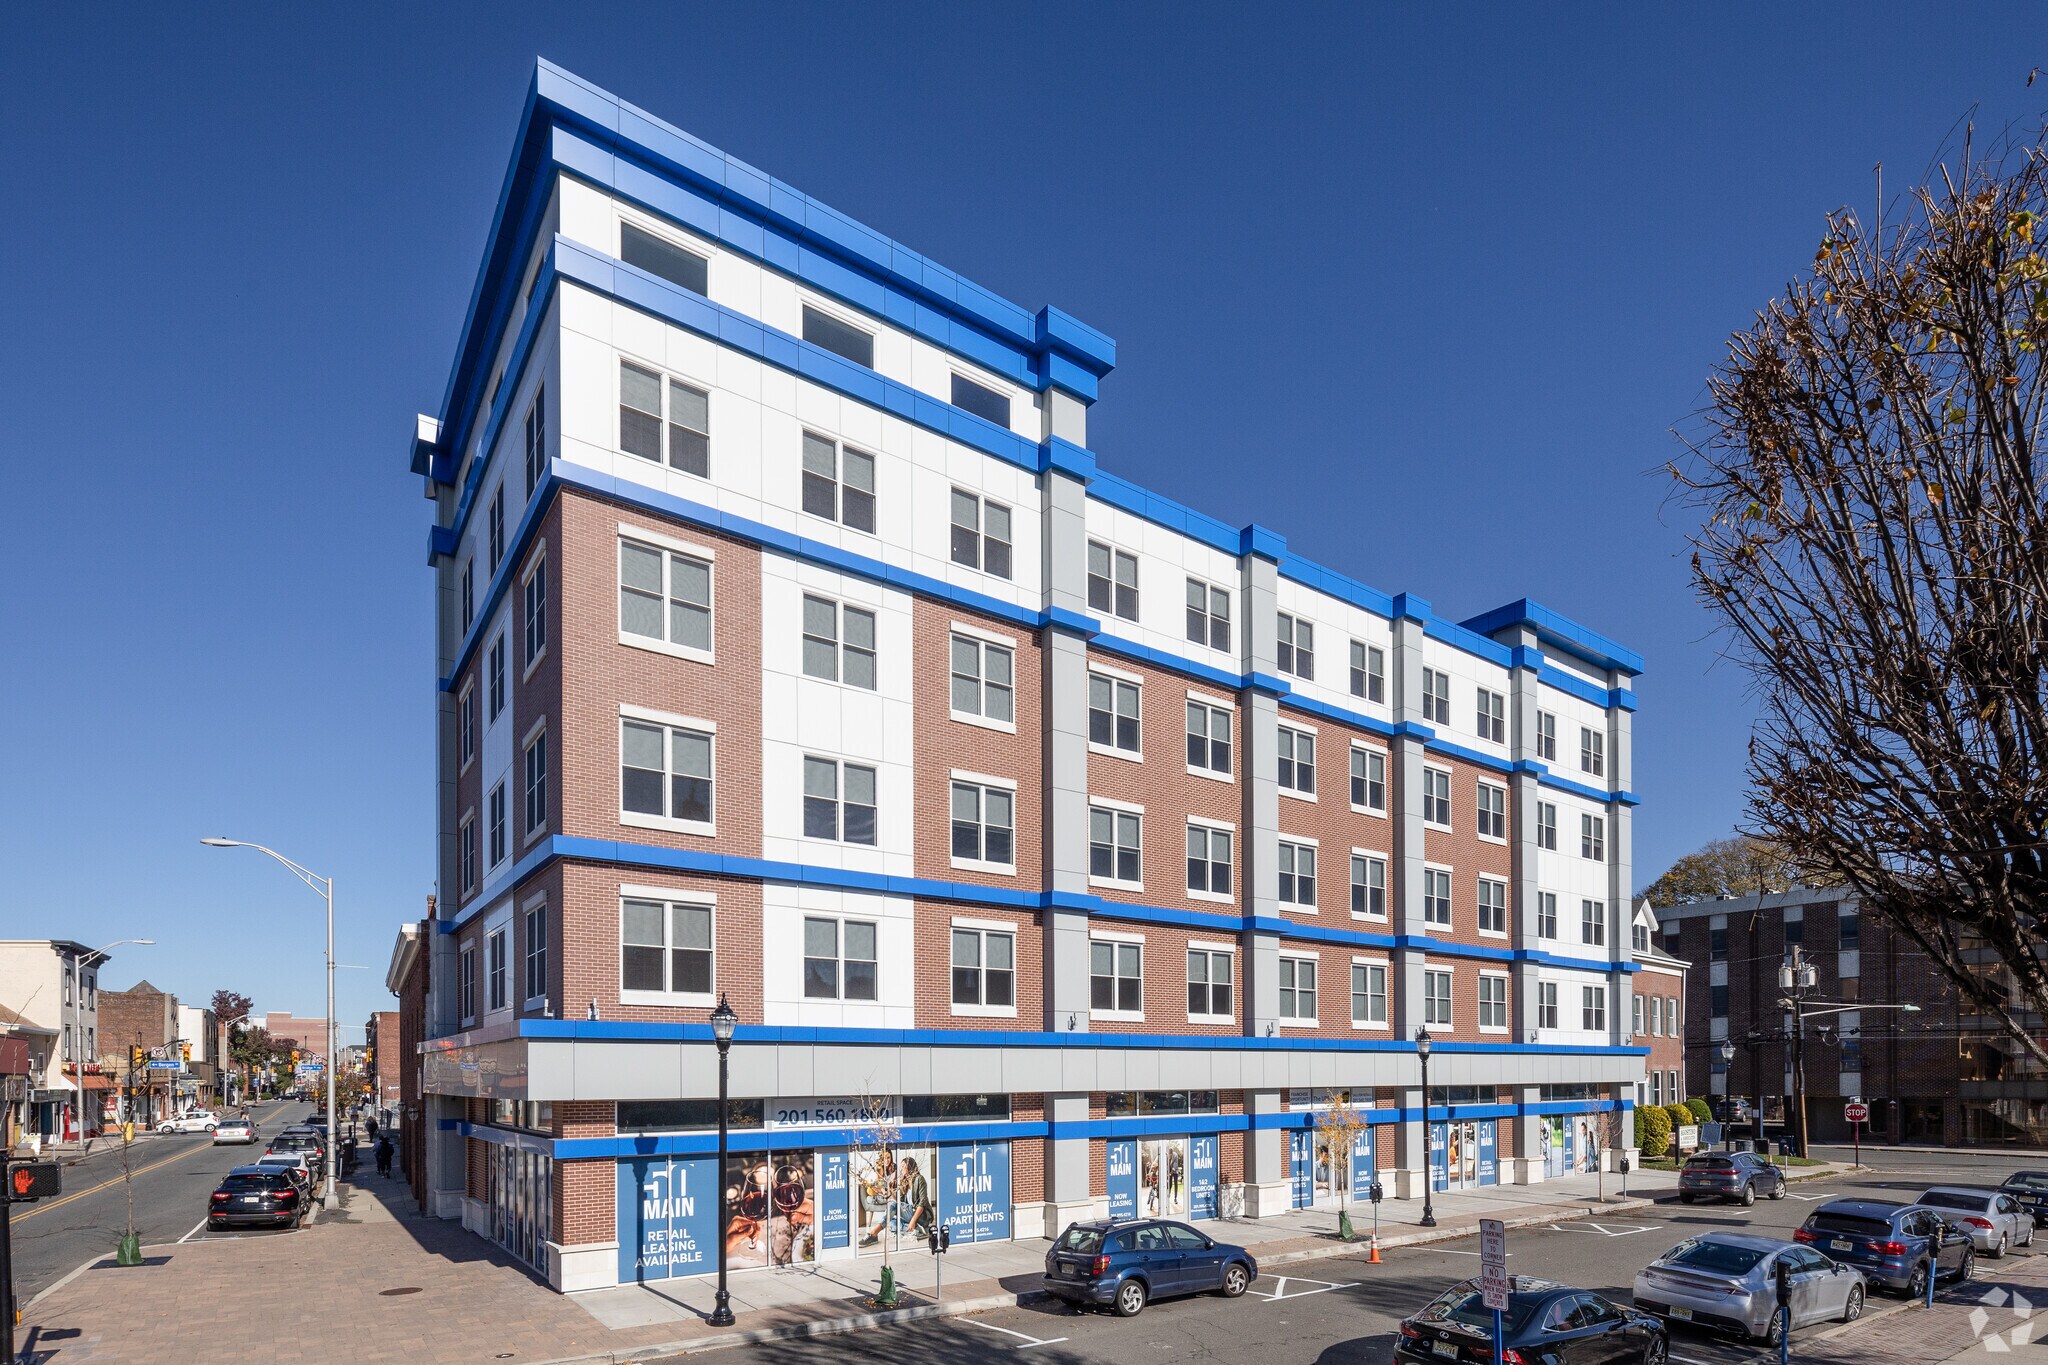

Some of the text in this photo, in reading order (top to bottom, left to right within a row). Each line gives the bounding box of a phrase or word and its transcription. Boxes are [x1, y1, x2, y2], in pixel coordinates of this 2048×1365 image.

[1846, 1109, 1866, 1117] STOP
[1193, 1157, 1213, 1169] MAIN
[1110, 1163, 1132, 1176] MAIN
[825, 1179, 845, 1190] MAIN
[956, 1175, 992, 1194] MAIN
[1354, 1175, 1371, 1183] LEASING
[1191, 1185, 1215, 1193] BEDROOM
[643, 1196, 695, 1220] MAIN
[1109, 1199, 1133, 1207] LEASING
[955, 1203, 993, 1215] LUXURY
[823, 1213, 847, 1221] LEASING
[944, 1212, 1005, 1226] APARTMENTS
[647, 1228, 691, 1242] RETAIL
[1483, 1230, 1502, 1238] PARKING
[642, 1240, 696, 1255] LEASING
[634, 1251, 703, 1268] AVAILABLE
[1489, 1269, 1498, 1277] NO
[1484, 1278, 1505, 1288] PARKING
[1487, 1298, 1503, 1306] COVERED
